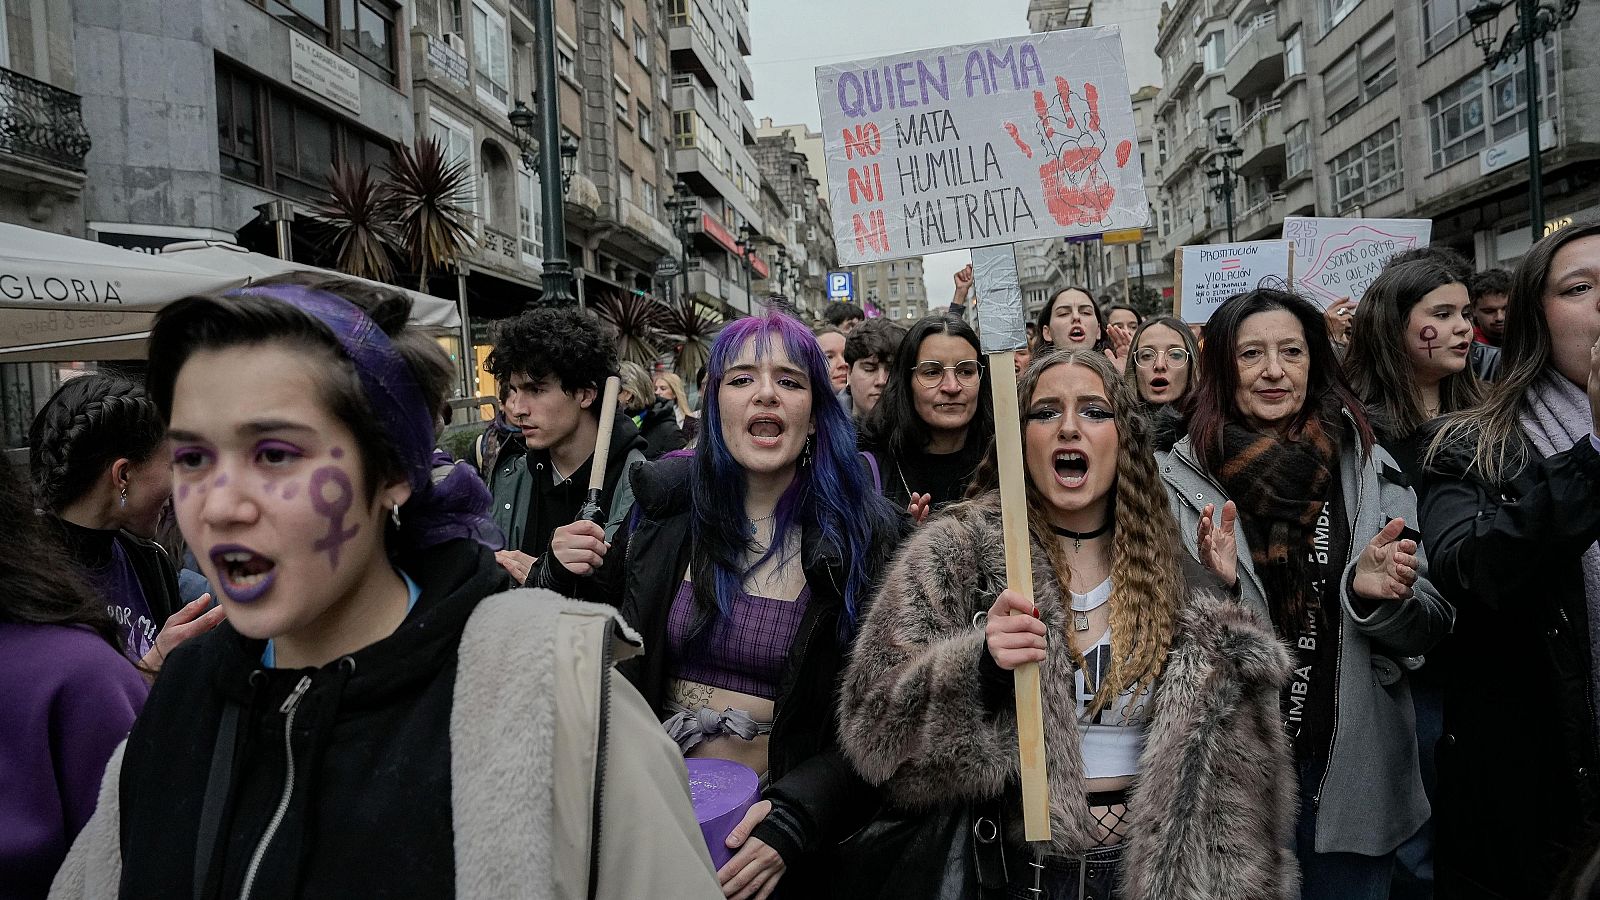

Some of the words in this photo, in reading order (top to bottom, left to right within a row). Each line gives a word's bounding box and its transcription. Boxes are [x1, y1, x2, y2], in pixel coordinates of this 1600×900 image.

[837, 55, 950, 118] QUIEN
[964, 41, 1046, 98] AMA
[842, 121, 881, 161] NO
[895, 109, 961, 149] MATA
[847, 162, 885, 205] NI
[896, 142, 1004, 196] HUMILLA
[852, 208, 892, 256] NI
[903, 186, 1039, 249] MALTRATA
[833, 275, 846, 290] P
[1321, 272, 1341, 286] DAS
[1345, 267, 1364, 281] QUE
[1364, 261, 1379, 275] XA
[1325, 248, 1359, 270] SOMOS
[1360, 249, 1367, 259] O
[1283, 665, 1313, 738] IMBA
